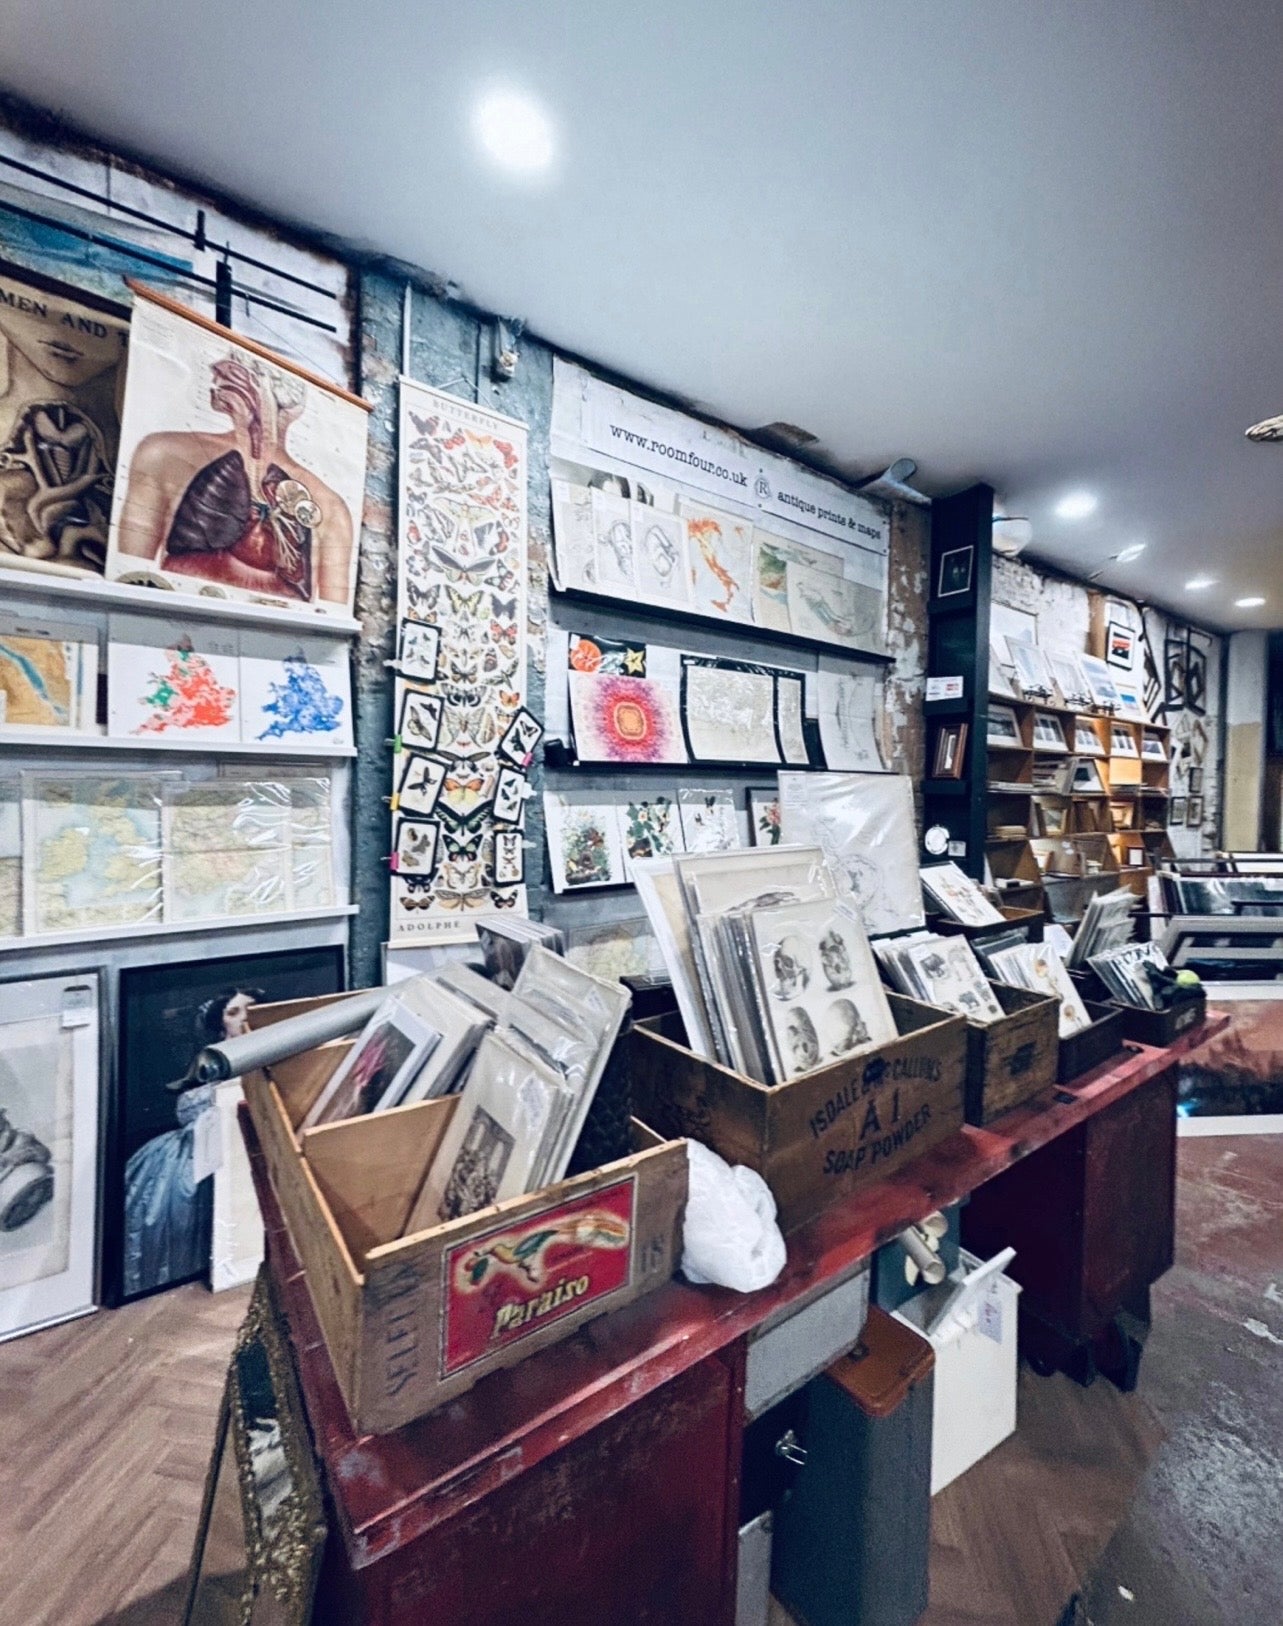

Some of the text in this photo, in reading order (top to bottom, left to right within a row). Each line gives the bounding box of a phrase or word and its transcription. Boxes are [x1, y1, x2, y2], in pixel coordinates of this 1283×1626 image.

[62, 312, 108, 339] AND
[609, 424, 748, 488] www.roomfour.co.uk
[777, 491, 882, 540] antique prints & maps
[398, 920, 461, 933] ADOLPHE
[809, 1078, 860, 1140] ISDALE
[822, 1103, 932, 1175] SOAP POWDER
[489, 1275, 591, 1340] Paraiso
